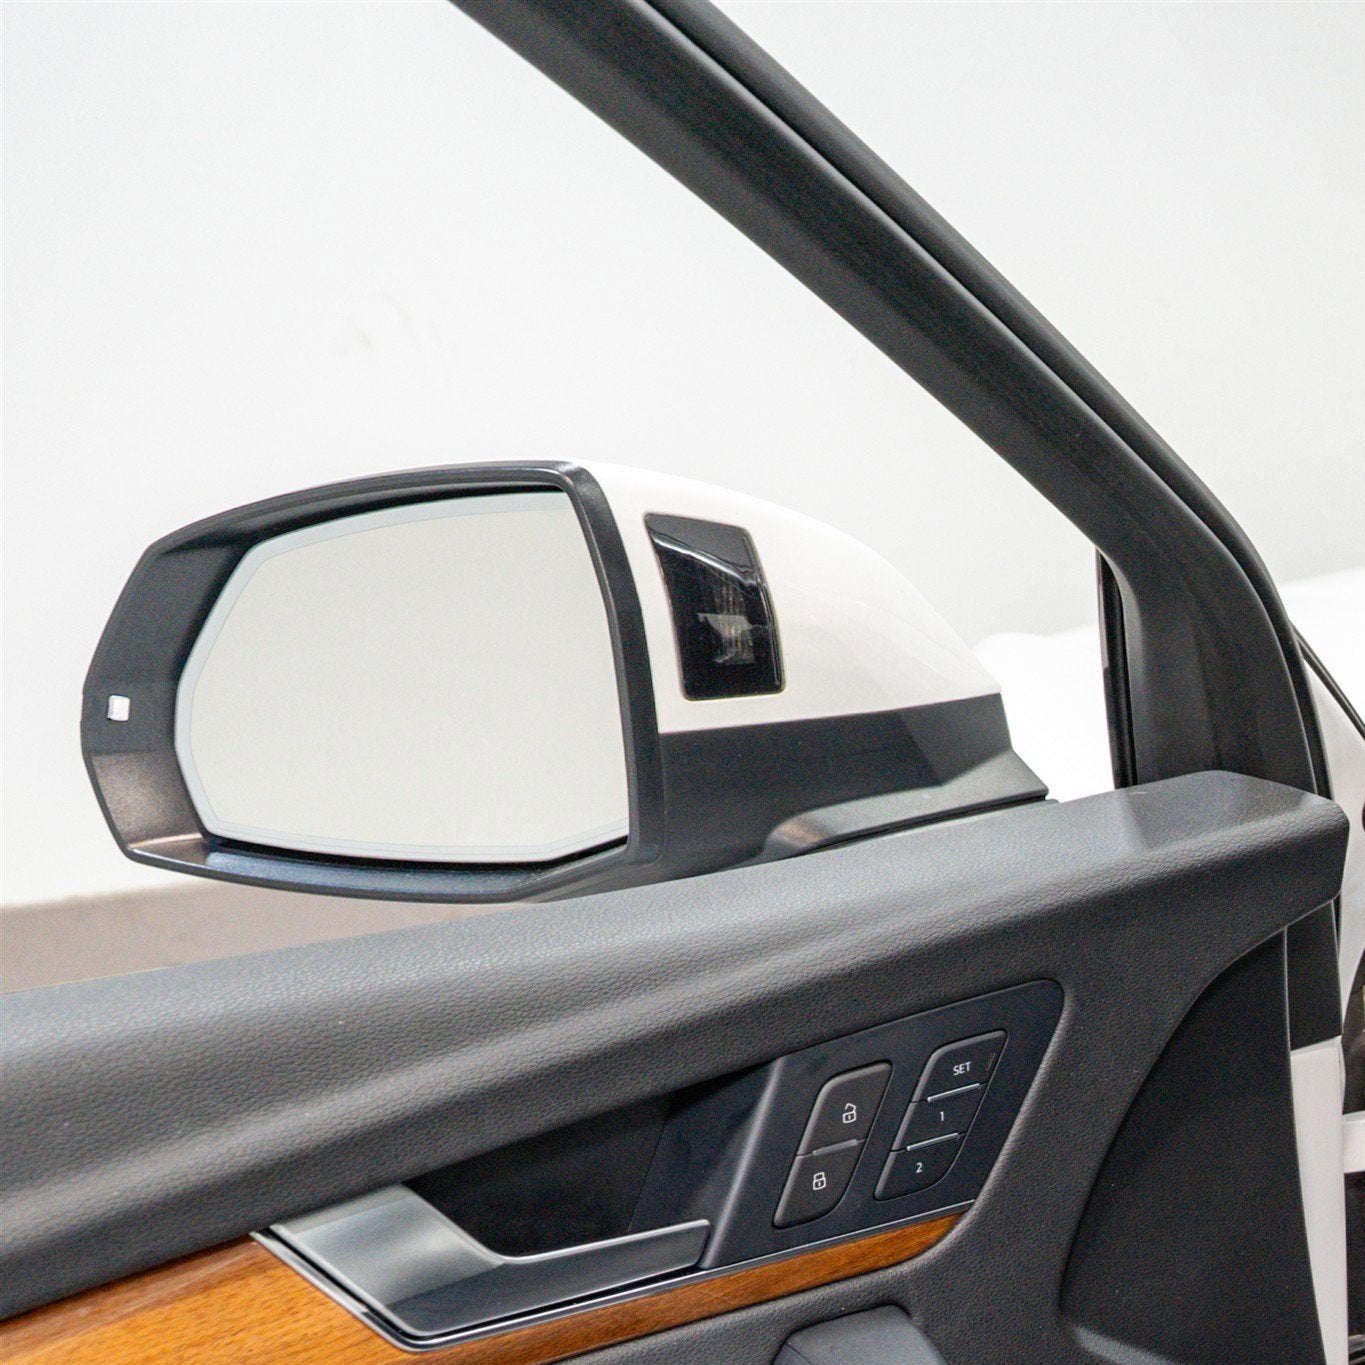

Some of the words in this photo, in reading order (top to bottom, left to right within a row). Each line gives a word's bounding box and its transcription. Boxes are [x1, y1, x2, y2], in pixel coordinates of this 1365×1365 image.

[953, 1061, 971, 1076] SET
[939, 1110, 945, 1122] 1
[915, 1162, 923, 1174] 2
